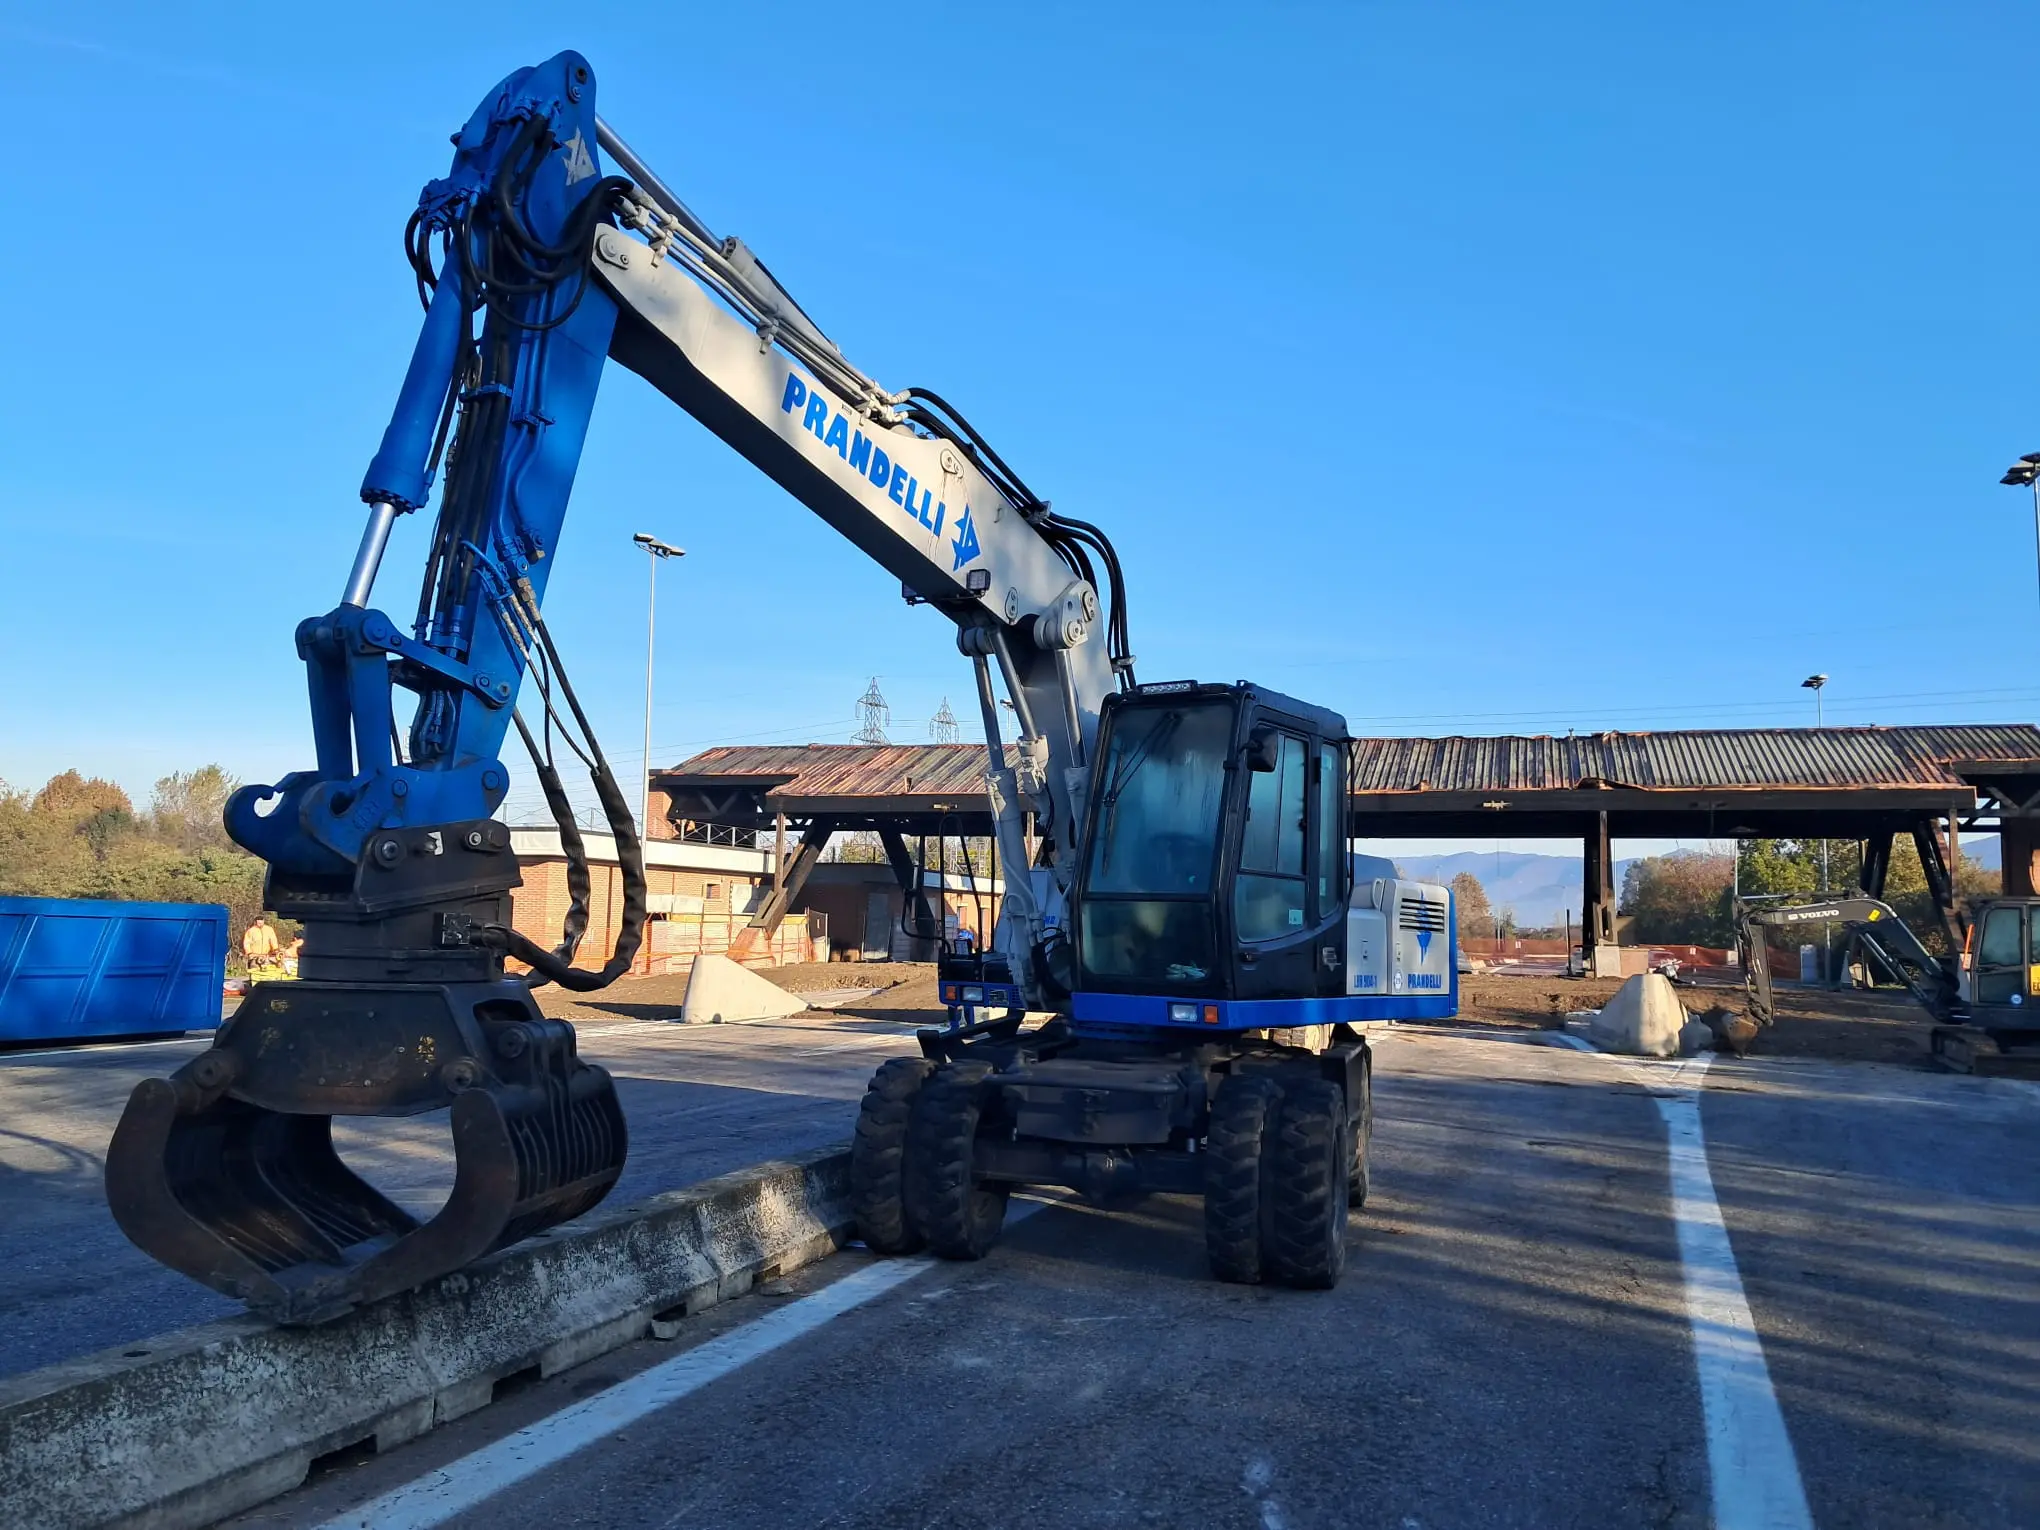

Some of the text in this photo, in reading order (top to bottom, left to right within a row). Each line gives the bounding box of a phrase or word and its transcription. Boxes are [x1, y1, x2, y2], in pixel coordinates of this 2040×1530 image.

[782, 372, 946, 537] PRANDELLI
[1799, 910, 1840, 919] VOLVO
[1408, 974, 1442, 988] PRANDELLI
